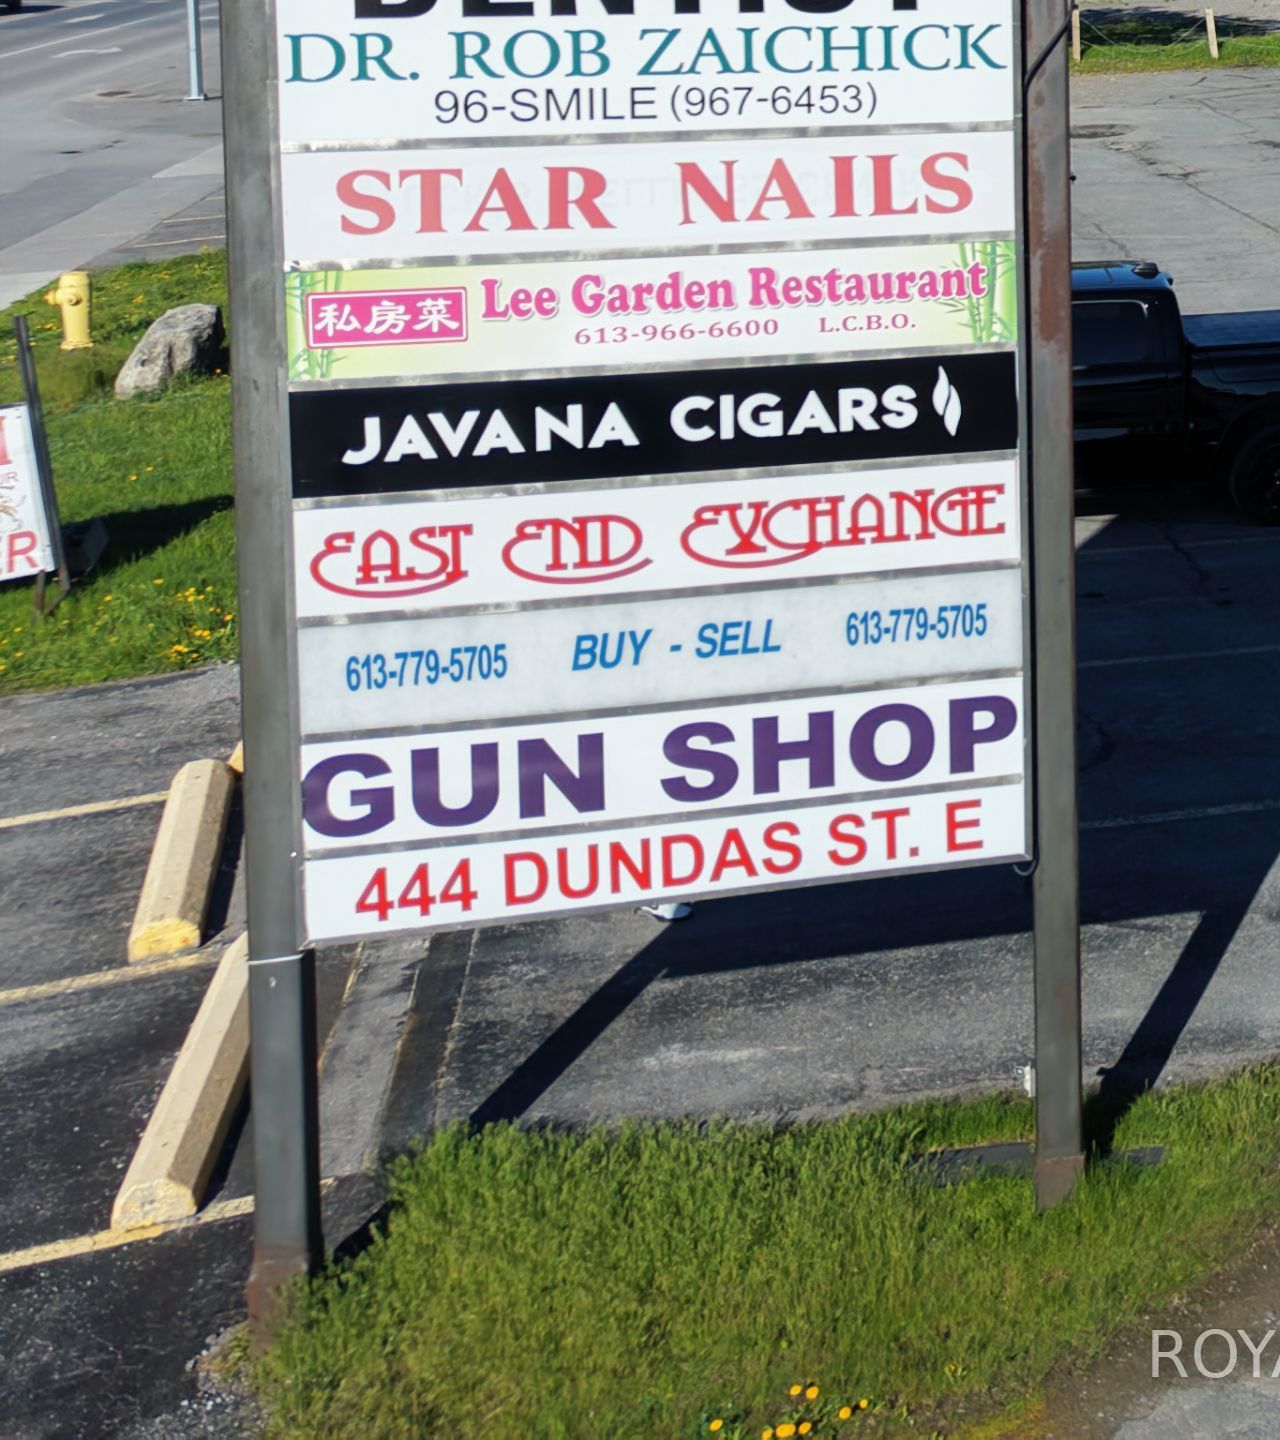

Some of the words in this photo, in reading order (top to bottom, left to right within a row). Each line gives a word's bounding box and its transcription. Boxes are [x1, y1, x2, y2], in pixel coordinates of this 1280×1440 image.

[284, 34, 418, 83] DR.
[449, 29, 609, 80] ROB
[638, 24, 1007, 76] ZAICHICK
[434, 87, 656, 124] 96-SMILE
[670, 83, 877, 119] (967-6453)
[335, 167, 616, 235] STAR
[679, 152, 973, 226] NAILS
[314, 298, 460, 337] 私房菜
[481, 279, 556, 320] Lee
[571, 271, 737, 318] Garden
[748, 263, 988, 308] Restaurant
[574, 319, 779, 346] 613-966-6600
[818, 313, 916, 334] L.C.B.O.
[342, 401, 640, 467] JAVANA
[670, 384, 918, 442] CIGARS
[309, 523, 473, 599] EAST
[502, 514, 653, 585] END
[680, 484, 1005, 569] EXCHANGE
[572, 629, 652, 672] BUY
[695, 618, 781, 659] SELL
[846, 603, 988, 647] 613-779-5705
[346, 644, 508, 693] 613-779-5705
[302, 733, 606, 838] GUN
[661, 695, 1018, 803] SHOP
[355, 858, 477, 922] 444
[504, 820, 802, 907] DUNDAS
[827, 807, 921, 865] ST.
[947, 799, 983, 852] E
